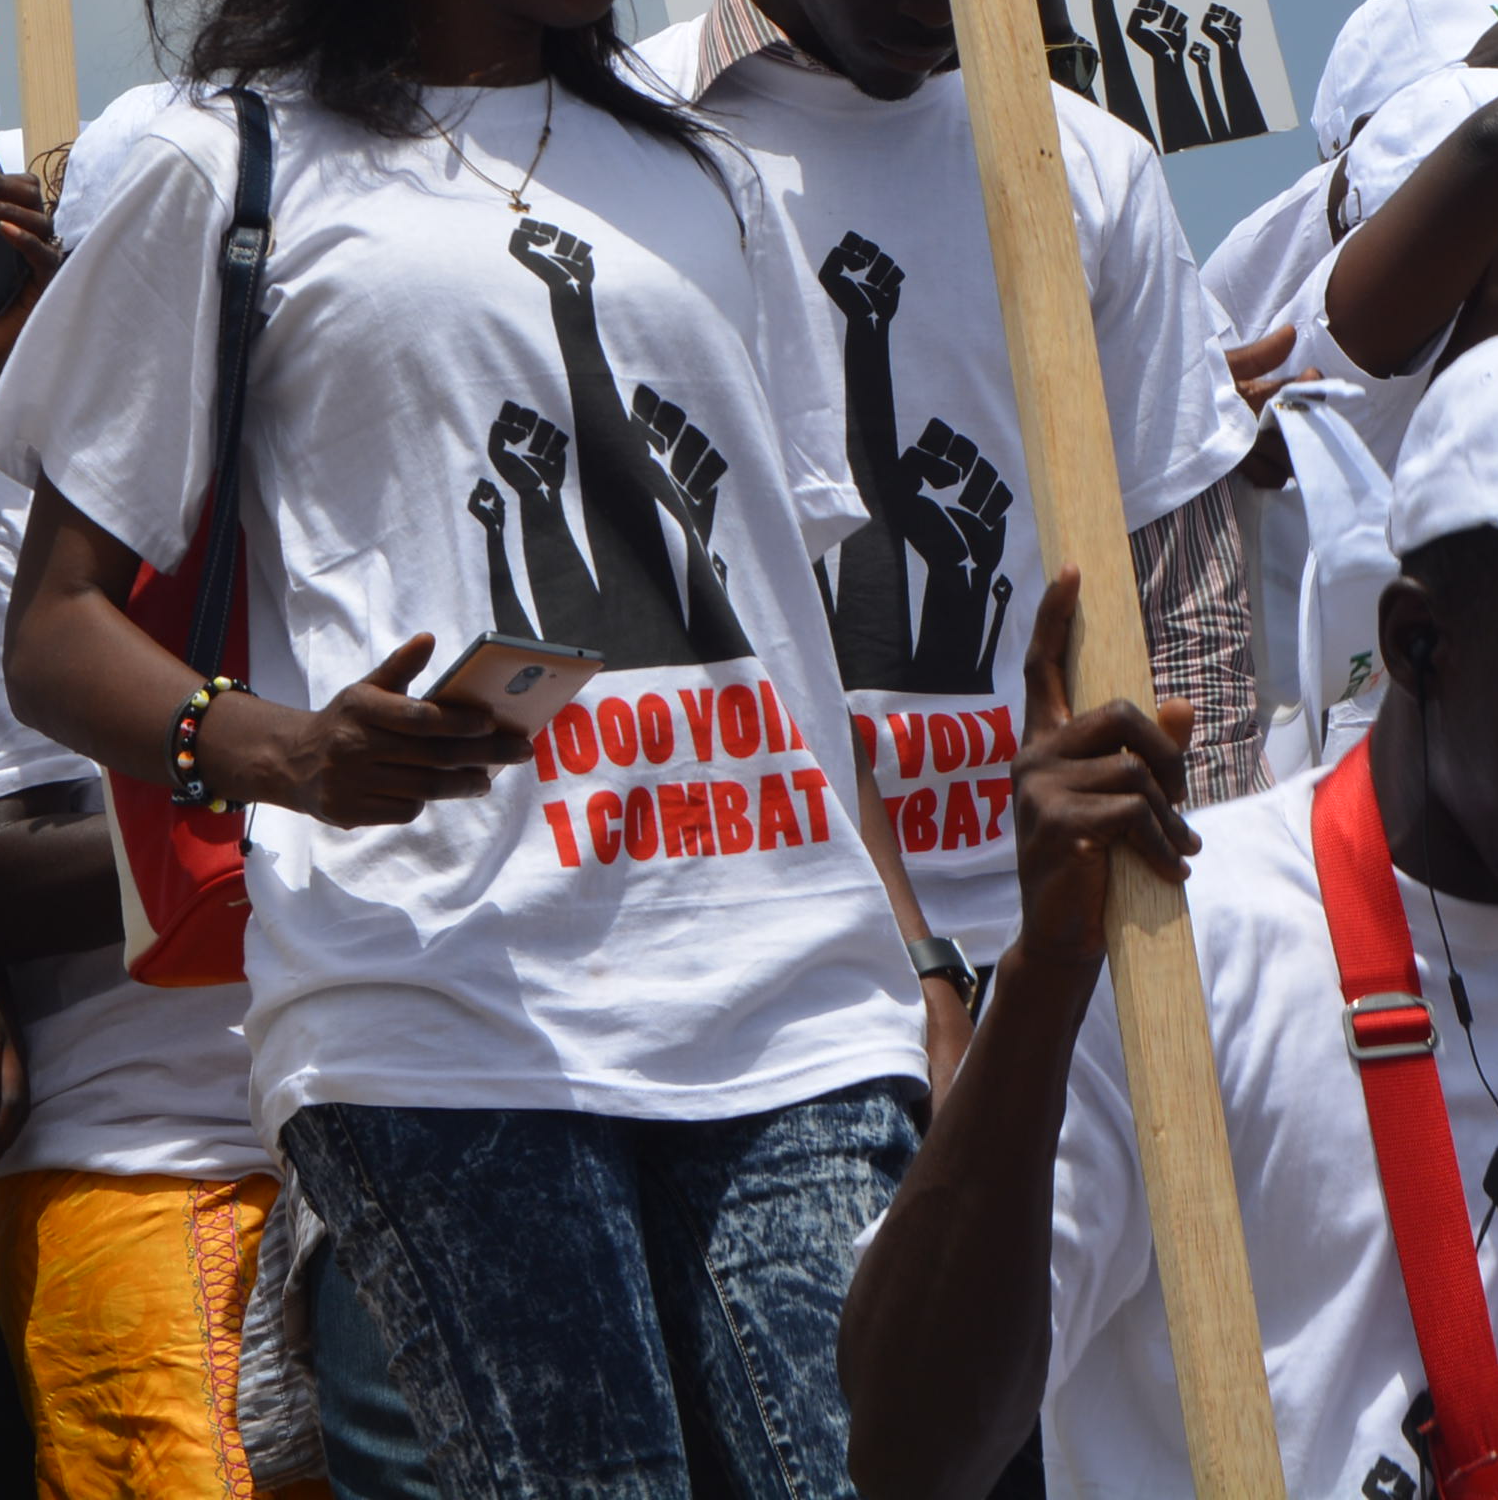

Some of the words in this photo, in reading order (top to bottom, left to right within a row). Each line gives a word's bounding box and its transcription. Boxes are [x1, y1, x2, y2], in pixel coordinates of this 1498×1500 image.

[886, 705, 1018, 779] VOIX
[543, 800, 581, 867] 1
[586, 768, 830, 865] COMBAT
